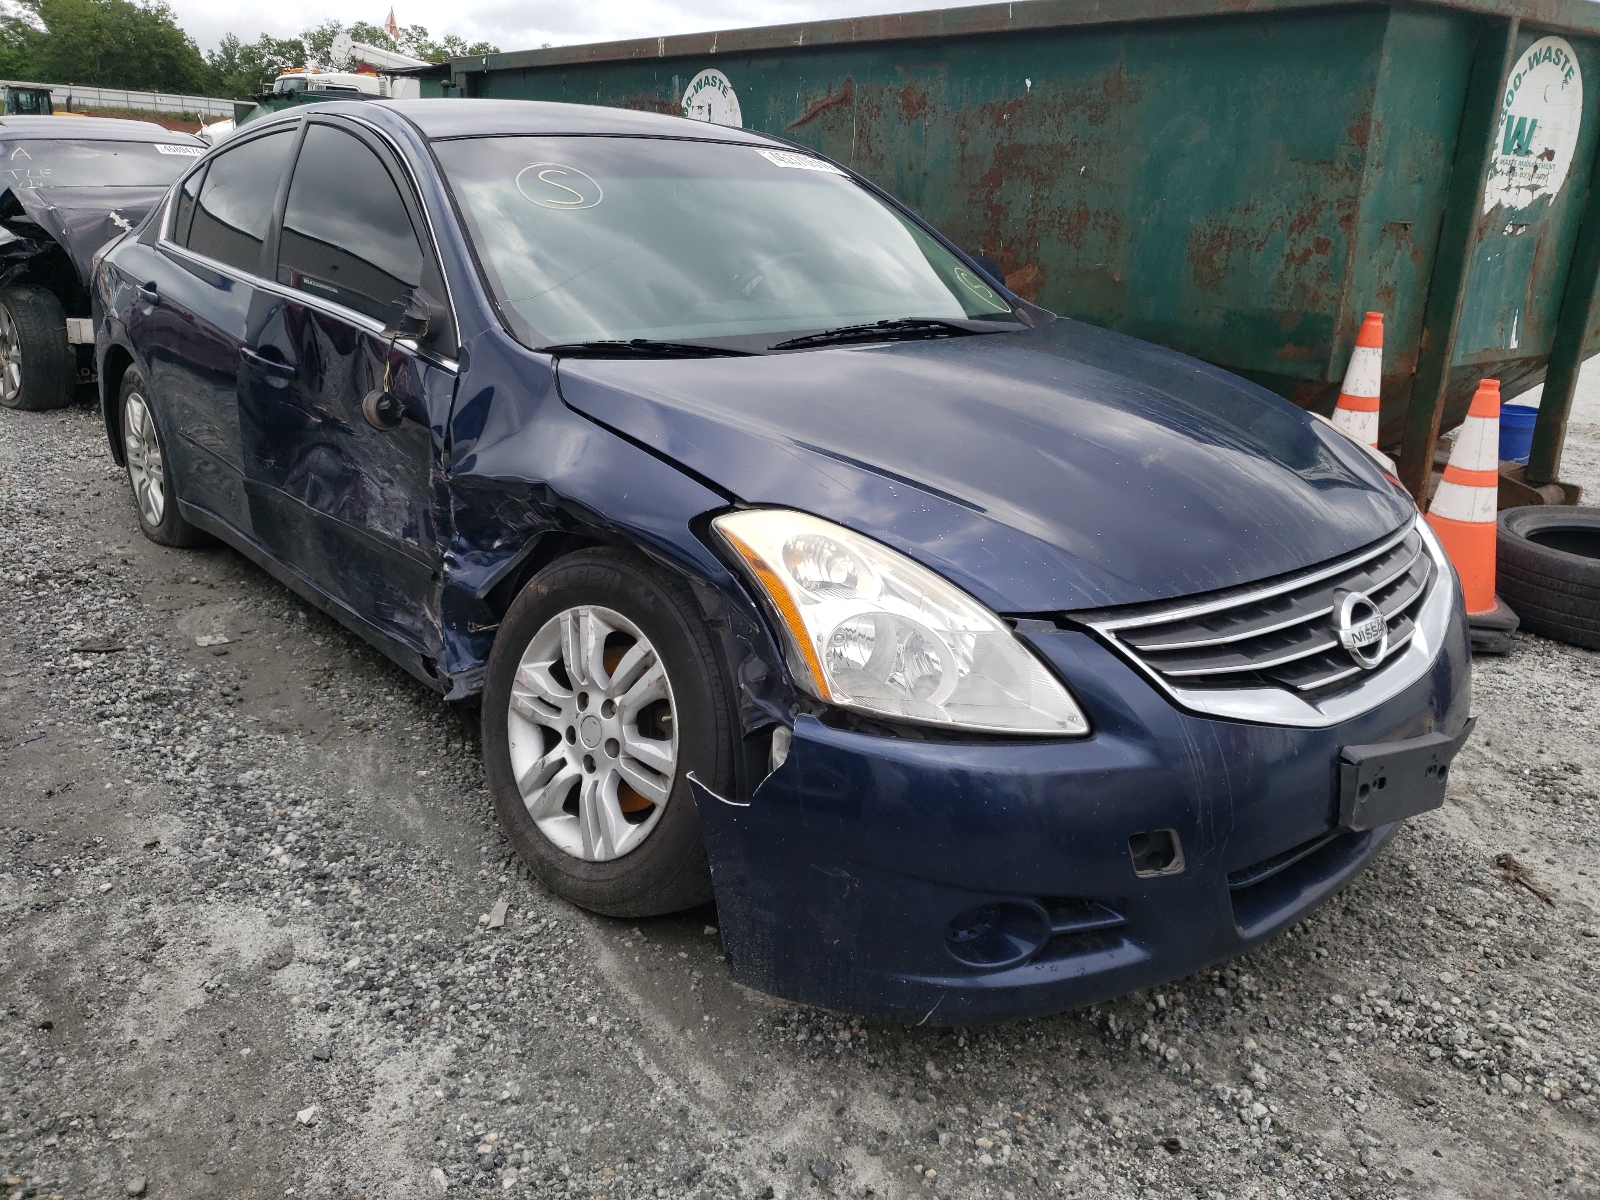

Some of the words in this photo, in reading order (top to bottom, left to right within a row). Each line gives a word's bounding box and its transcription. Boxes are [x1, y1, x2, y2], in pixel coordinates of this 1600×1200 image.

[1519, 160, 1556, 170] MANAEMENT
[537, 169, 585, 205] S
[1351, 618, 1387, 645] NISSAN
